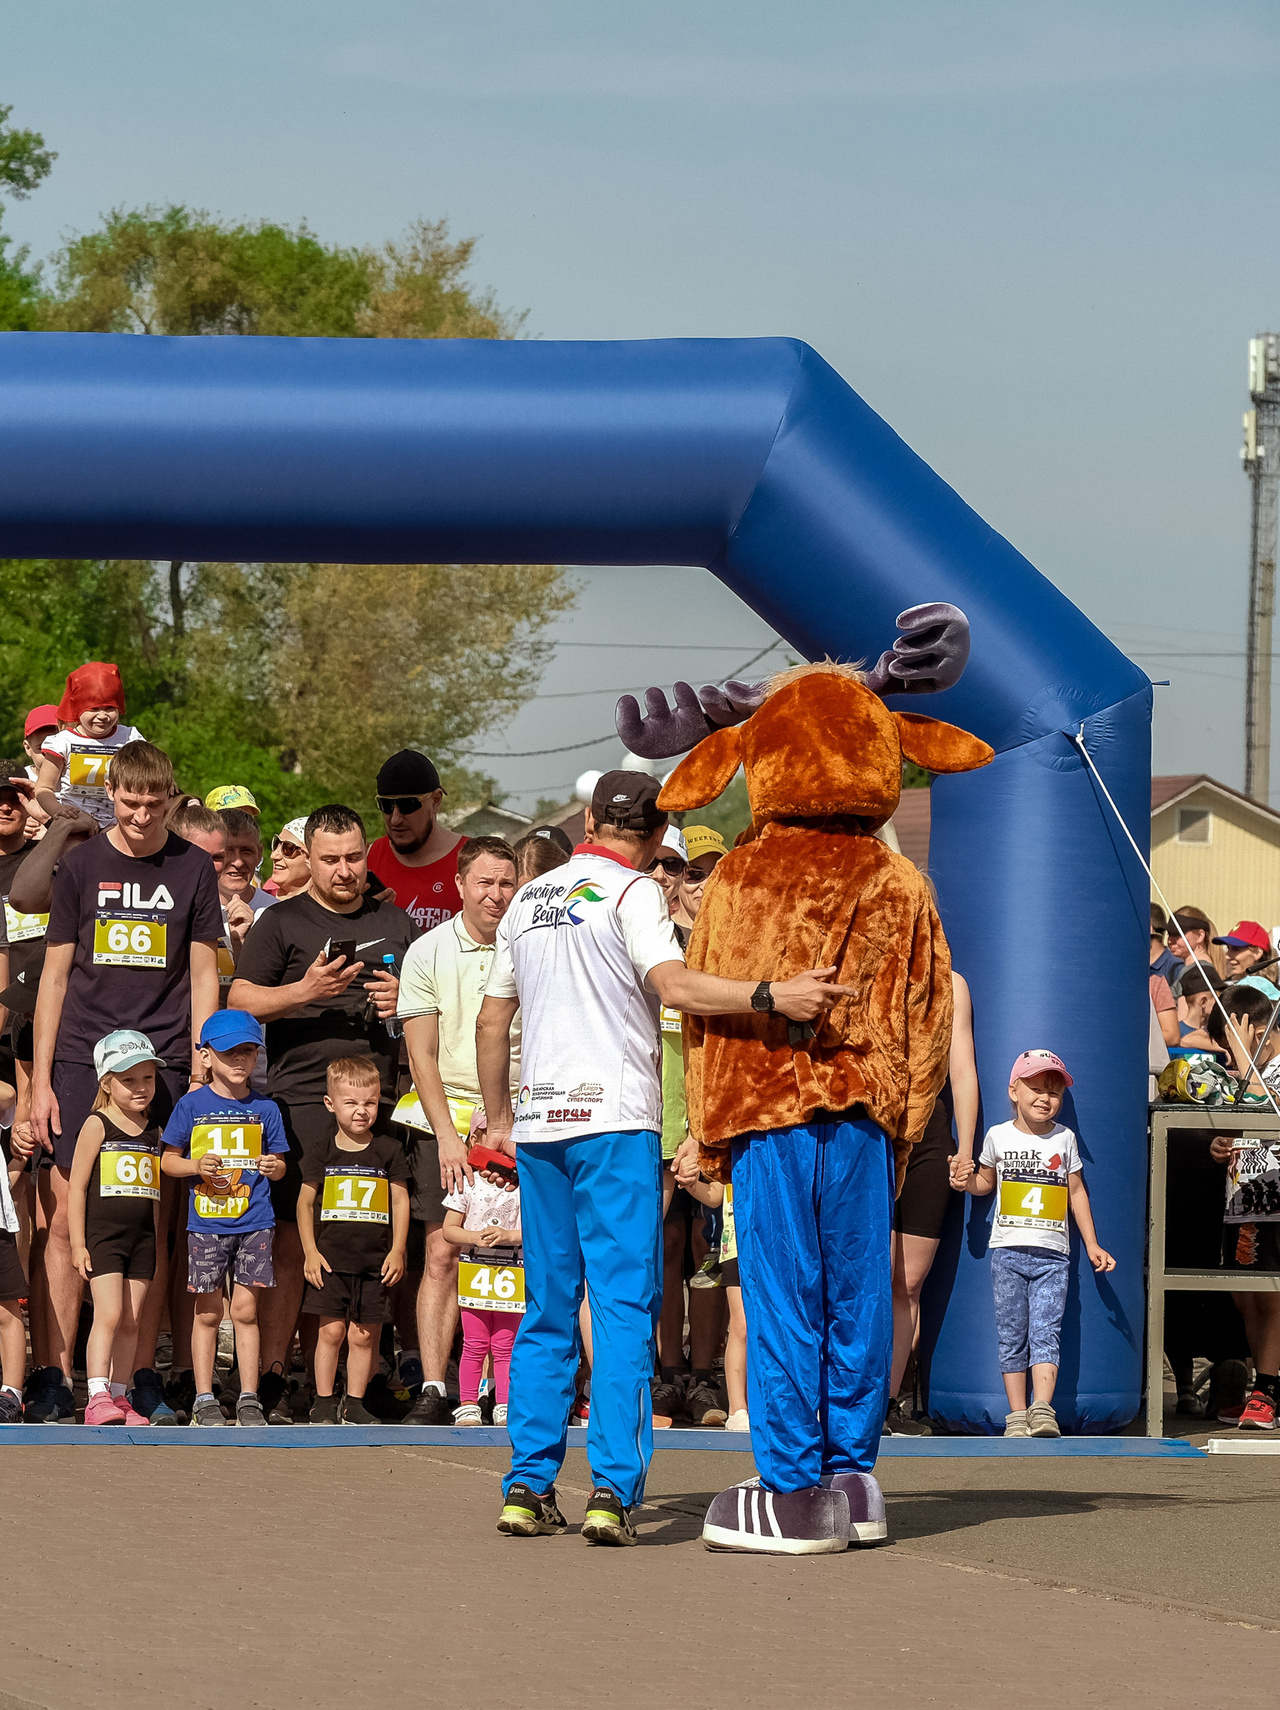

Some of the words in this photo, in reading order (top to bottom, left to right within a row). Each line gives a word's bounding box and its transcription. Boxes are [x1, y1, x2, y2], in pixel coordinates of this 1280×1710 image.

[84, 757, 111, 784] 7
[98, 882, 175, 910] FILA
[108, 923, 152, 953] 66
[546, 1109, 592, 1122] перцы
[207, 1127, 250, 1156] 11
[116, 1155, 153, 1185] 66
[336, 1179, 377, 1208] 17
[1021, 1187, 1045, 1215] 4
[471, 1268, 516, 1299] 46
